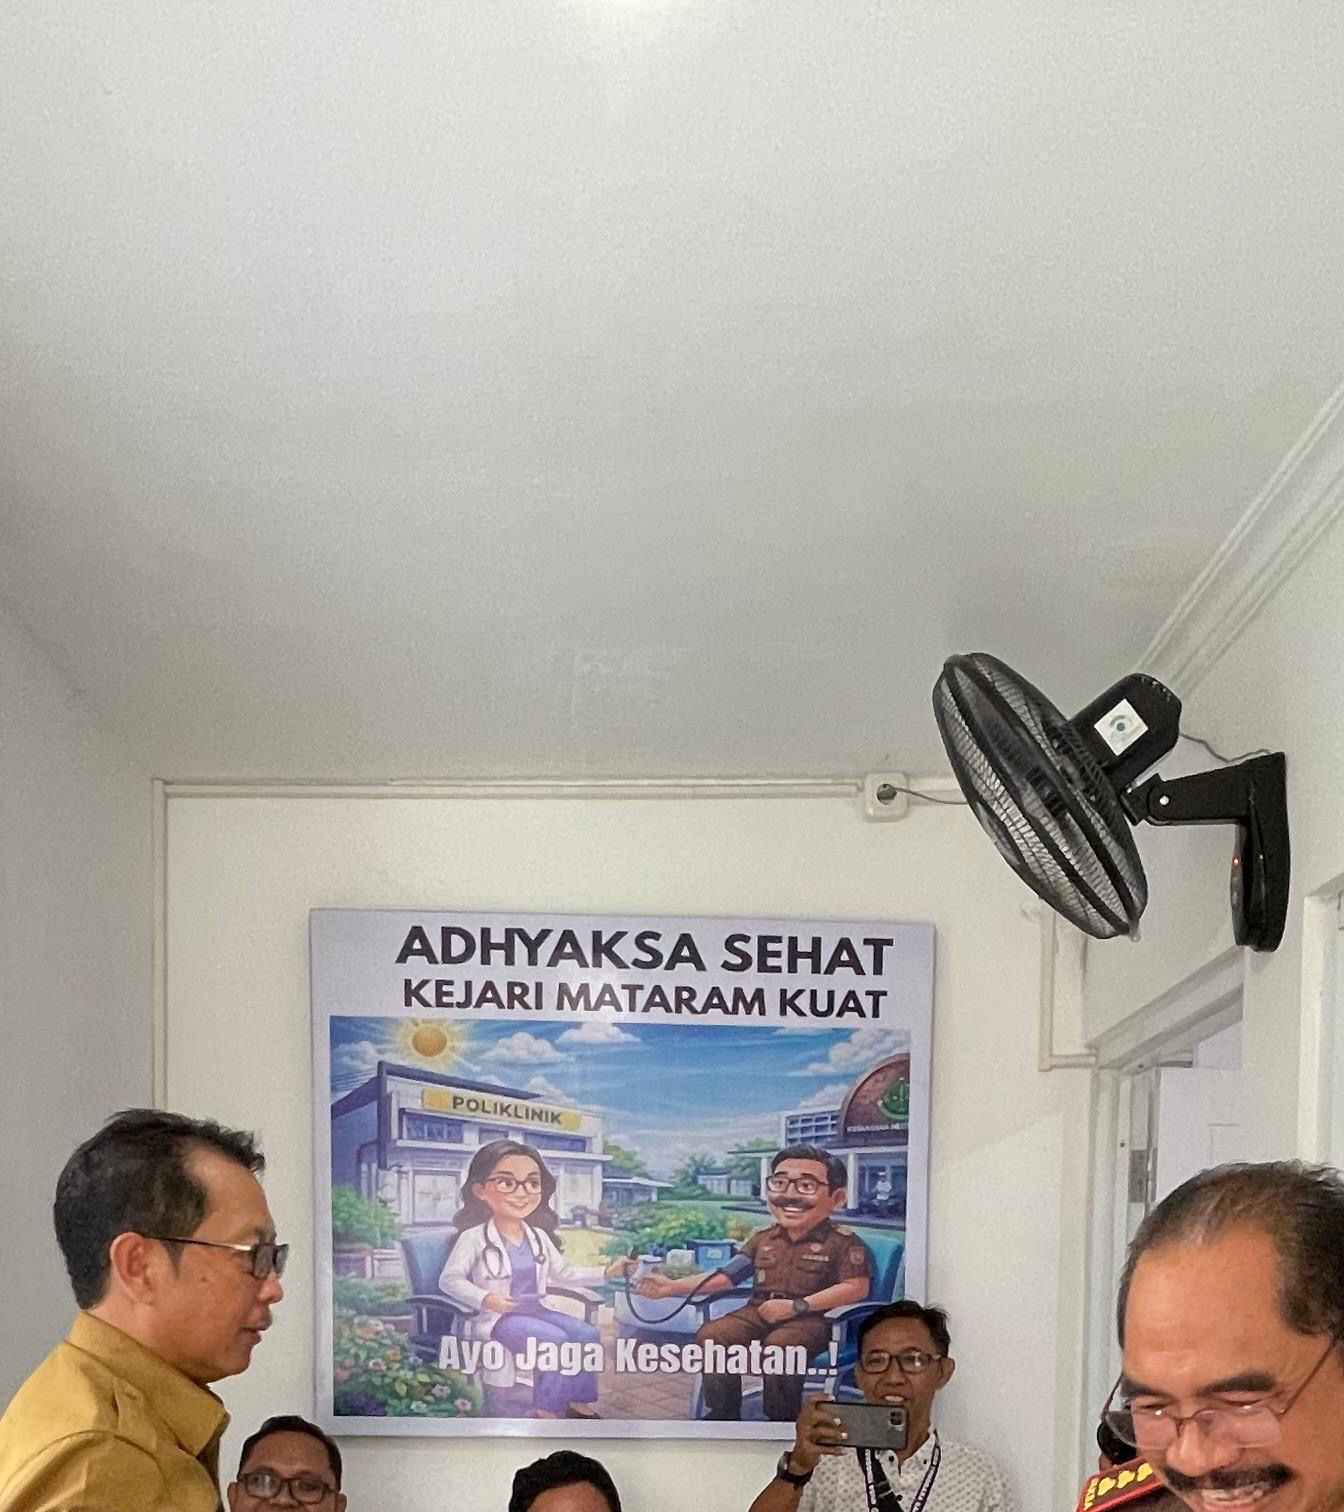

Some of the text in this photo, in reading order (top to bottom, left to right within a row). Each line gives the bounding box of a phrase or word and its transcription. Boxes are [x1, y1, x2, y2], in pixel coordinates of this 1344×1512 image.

[394, 925, 894, 976] ADHYAKSA SEHAT
[403, 978, 888, 1019] KEJARI MATARAM KUAT
[452, 1096, 562, 1125] POLIKLINIK
[438, 1335, 505, 1375] Ayo
[515, 1336, 604, 1377] Jaga
